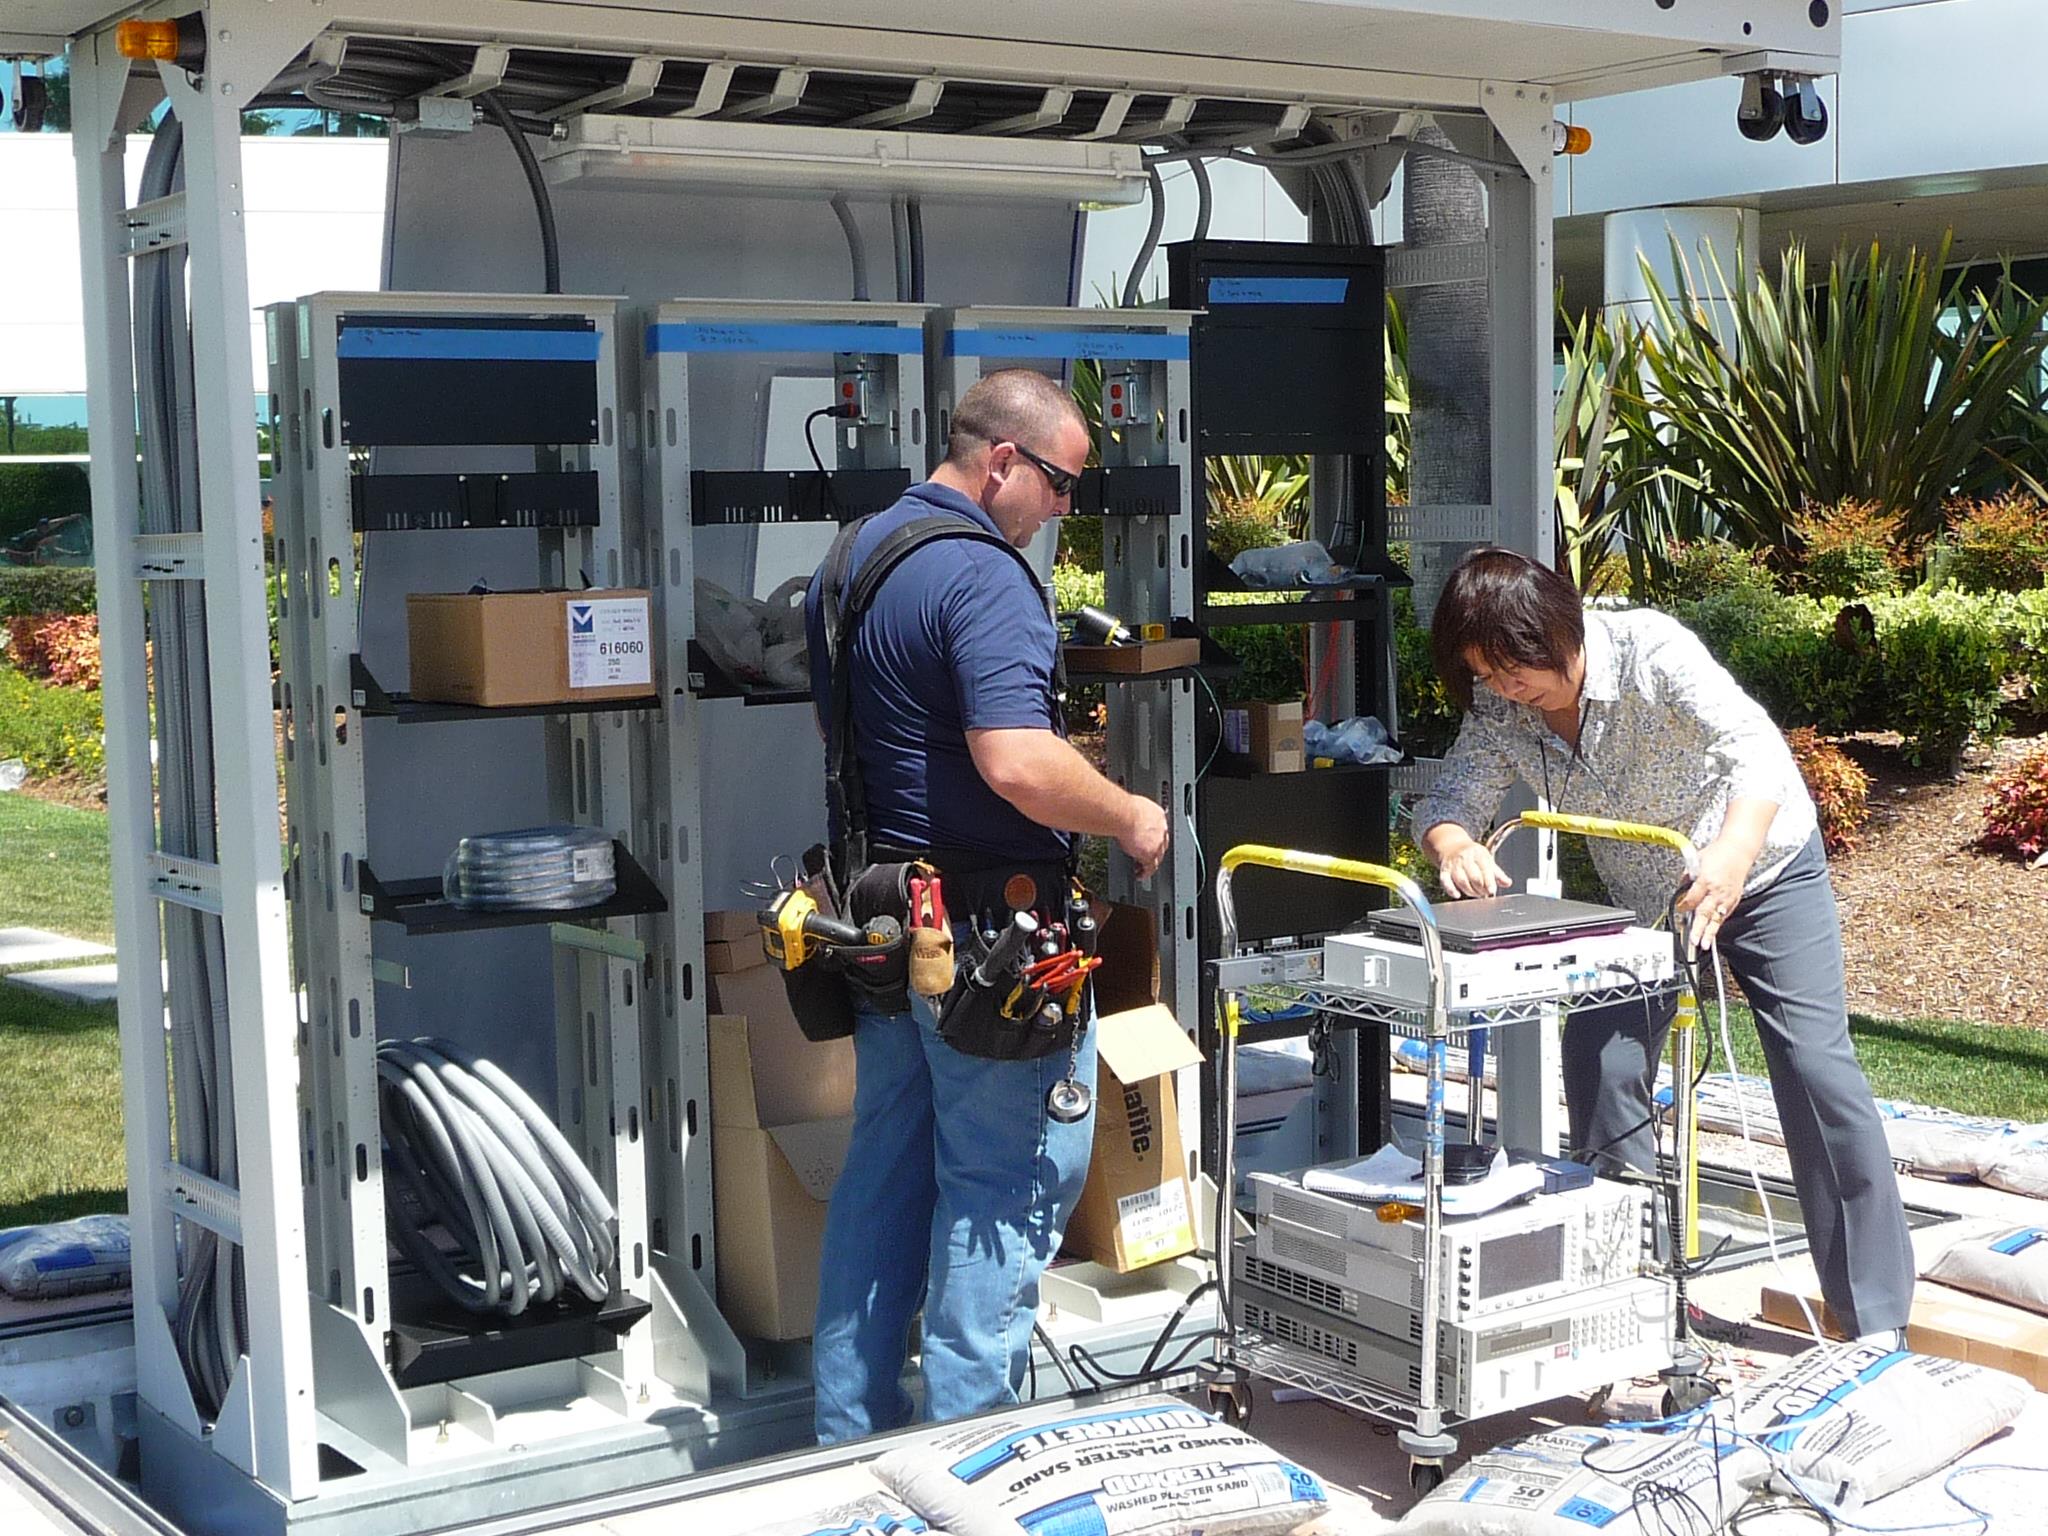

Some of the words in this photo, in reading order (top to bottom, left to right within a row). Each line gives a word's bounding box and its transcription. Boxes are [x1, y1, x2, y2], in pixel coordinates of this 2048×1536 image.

[599, 641, 644, 655] 616060
[1009, 1409, 1212, 1462] QUIKRETE
[1075, 1443, 1174, 1469] PLASTER
[1008, 1457, 1072, 1494] SAND
[1102, 1460, 1231, 1497] QUIKRETE
[1106, 1493, 1158, 1514] WASHED
[1160, 1483, 1214, 1501] PLASTER
[1216, 1478, 1249, 1494] SAND
[1512, 1485, 1546, 1499] 50
[1575, 1502, 1598, 1518] 50
